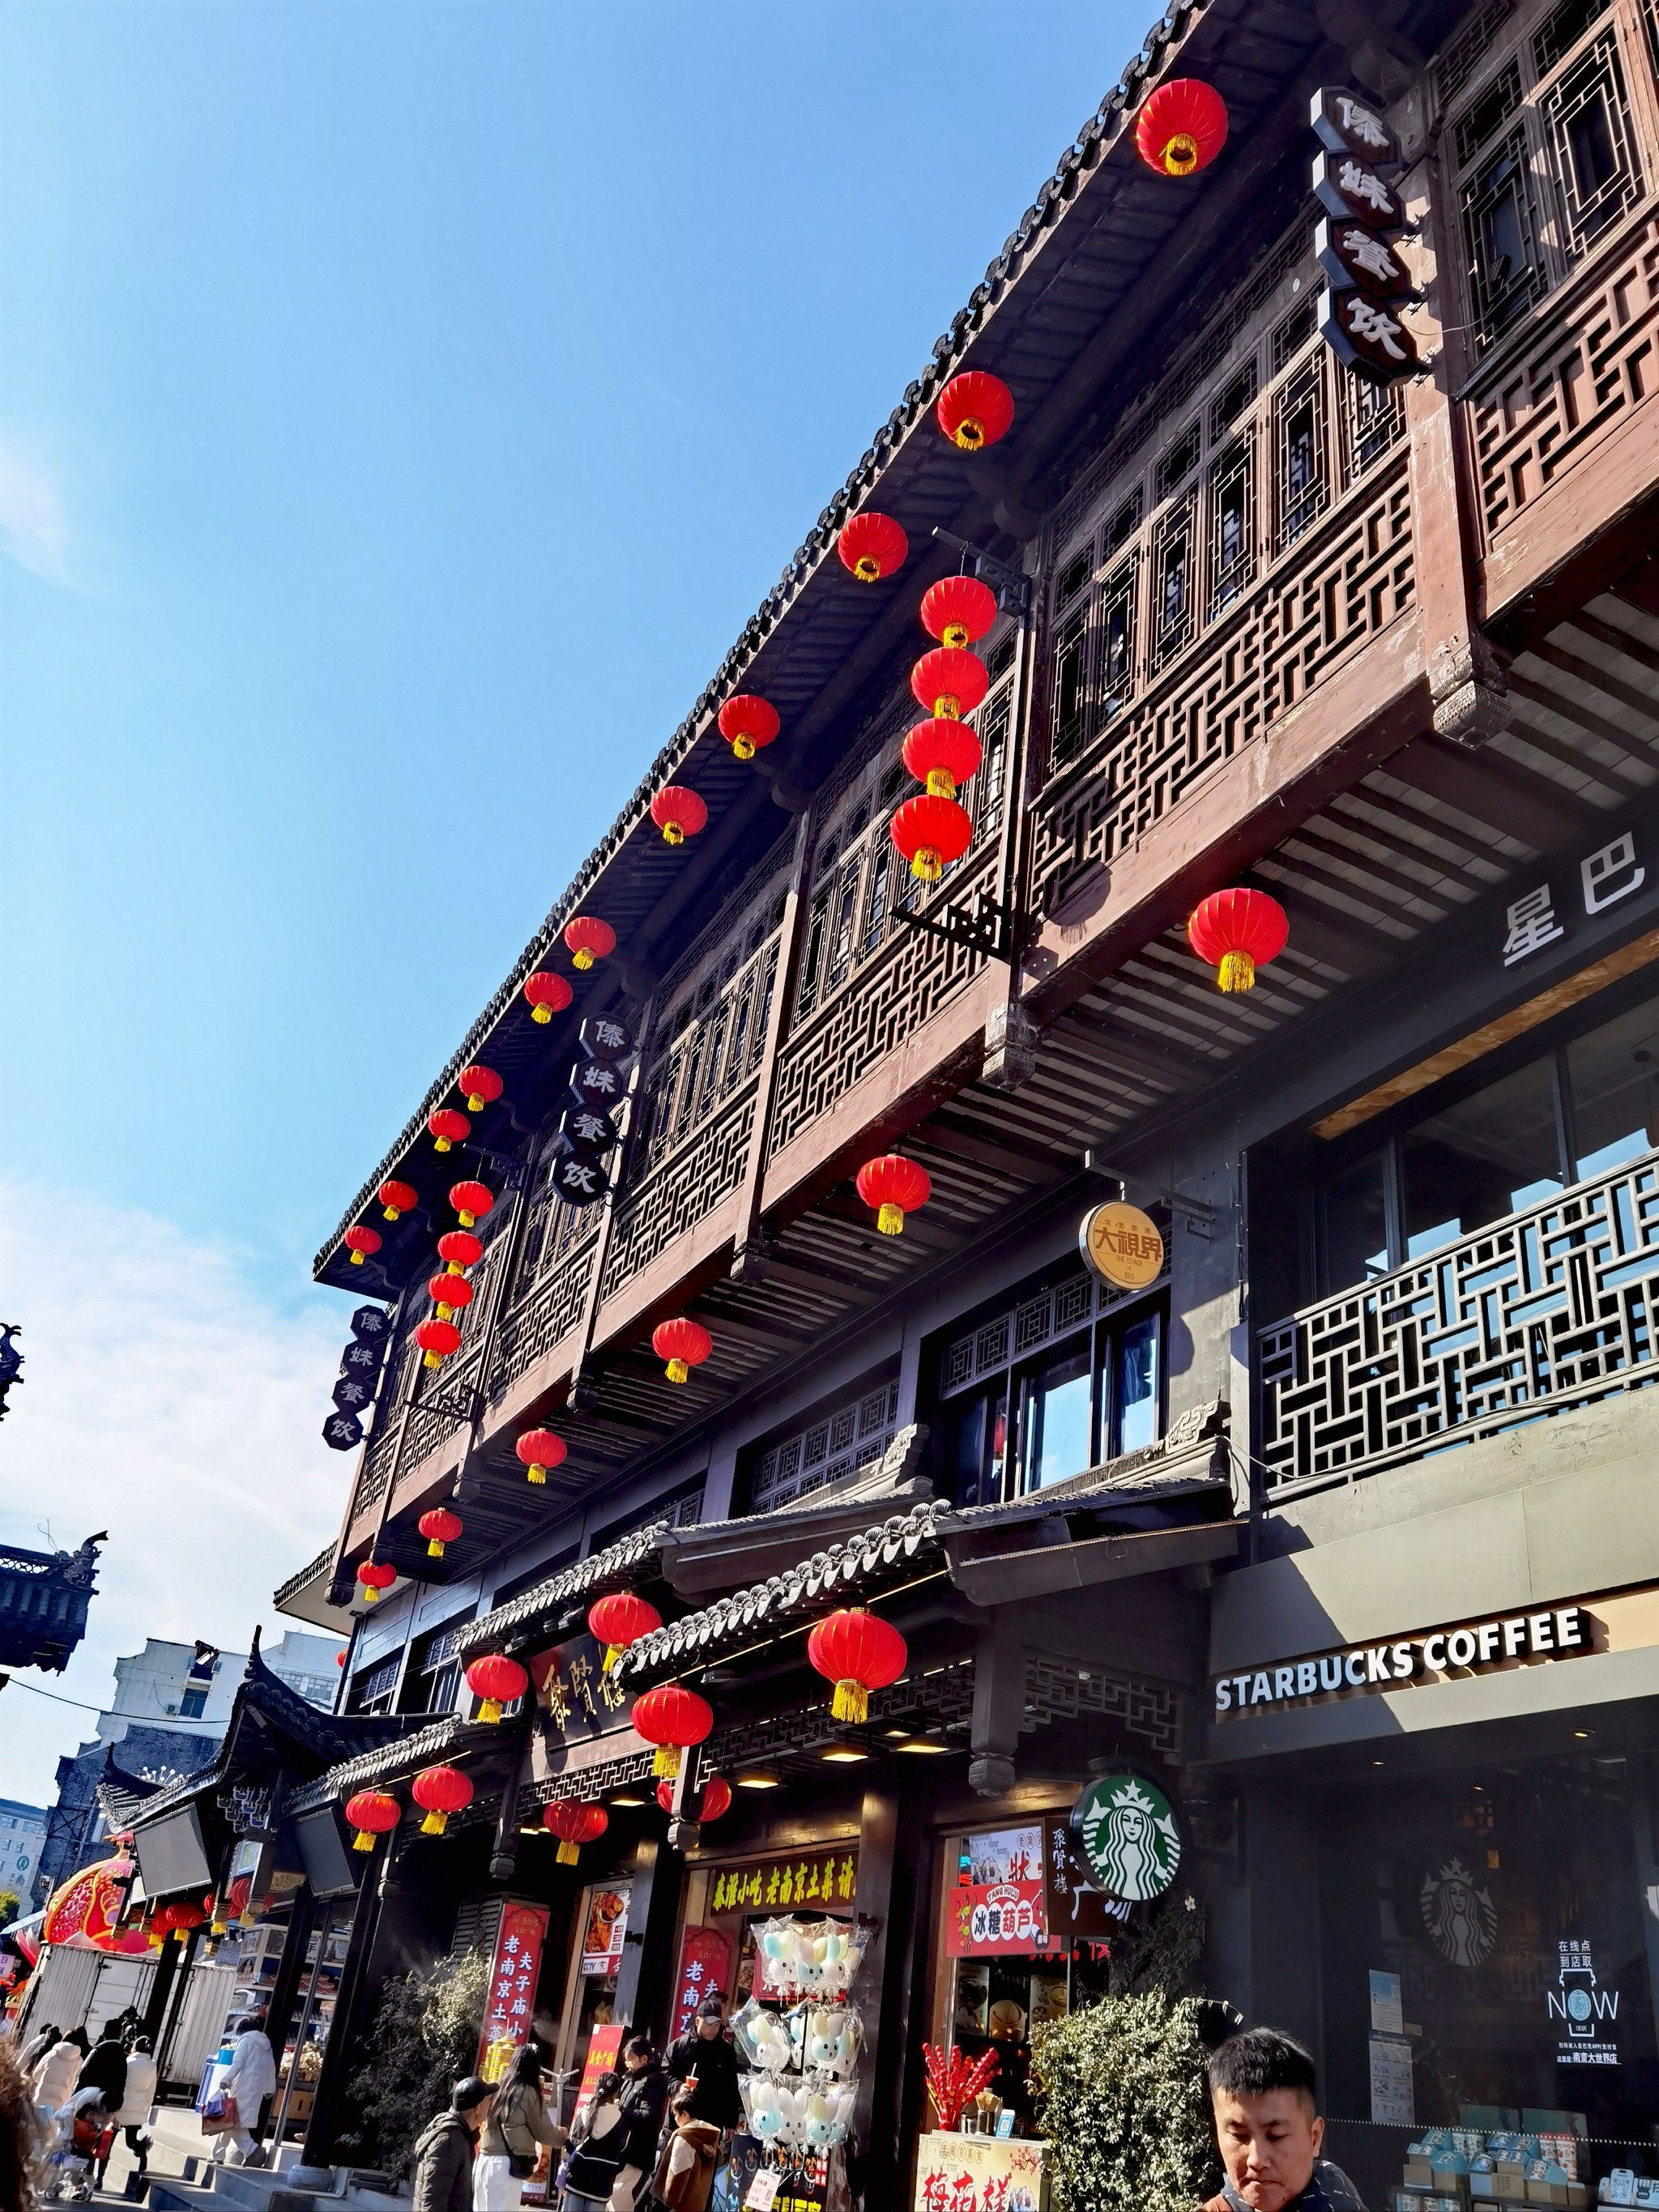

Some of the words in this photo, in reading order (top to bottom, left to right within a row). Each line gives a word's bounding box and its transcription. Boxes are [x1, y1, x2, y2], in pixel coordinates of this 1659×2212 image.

[1502, 830, 1645, 967] 星巴
[563, 1021, 625, 1193] 傣妹餐饮
[331, 1312, 382, 1441] 傣妹餐饮
[1215, 1641, 1414, 1711] STARBUCKS
[1423, 1607, 1581, 1670] COFFEE
[766, 1858, 834, 1904] 老南京土菜
[987, 1886, 1004, 1902] TANG
[974, 1906, 1031, 1937] 冰糖葫芦
[1559, 1940, 1591, 1953] 在线点
[1559, 1955, 1593, 1968] 到店取
[583, 1962, 596, 1971] CCTV
[488, 1935, 520, 2044] 老南京土菜
[1547, 1989, 1618, 2021] NOW
